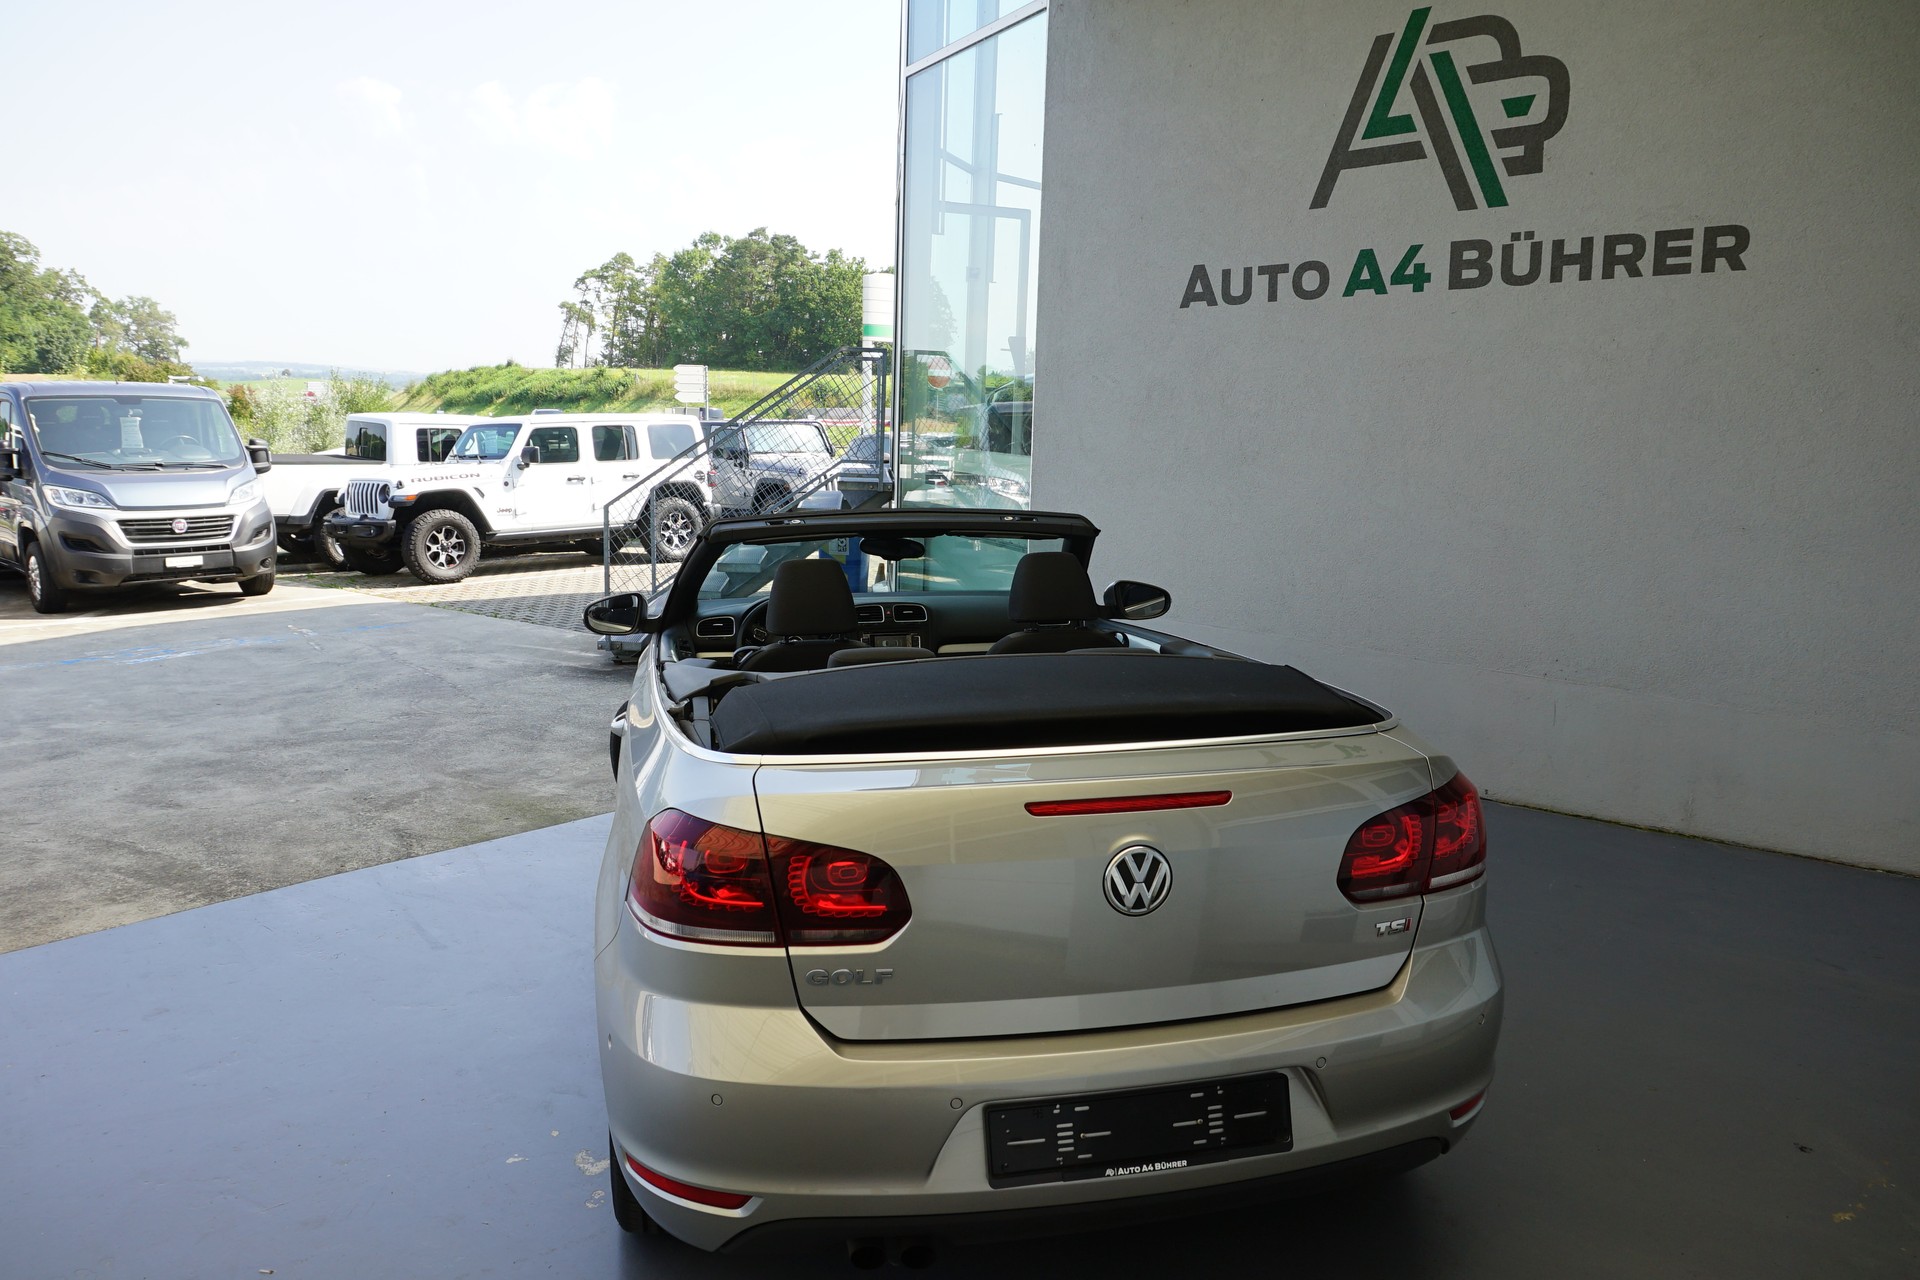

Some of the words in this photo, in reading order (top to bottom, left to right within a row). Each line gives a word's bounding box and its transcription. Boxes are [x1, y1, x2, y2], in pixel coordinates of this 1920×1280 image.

[1179, 260, 1330, 309] AUTO
[1342, 243, 1432, 298] A4
[1447, 224, 1751, 292] BÜHRER
[411, 473, 480, 483] RUBICON
[805, 968, 894, 985] GOLF
[1117, 1166, 1141, 1176] AUTO
[1141, 1163, 1154, 1173] A4
[1154, 1160, 1187, 1171] BÜHRER
